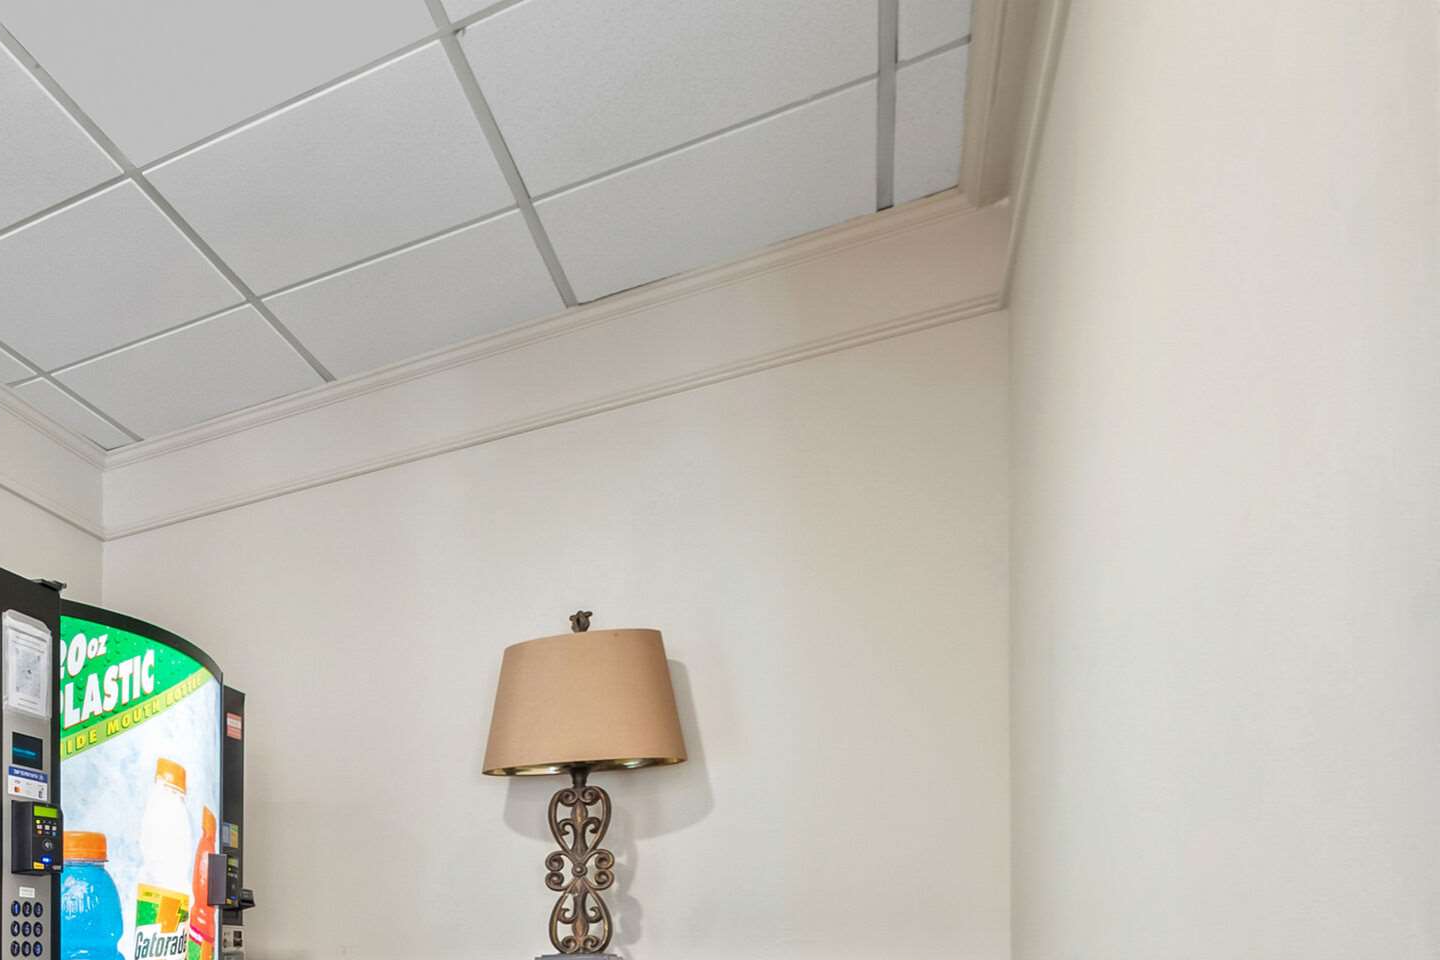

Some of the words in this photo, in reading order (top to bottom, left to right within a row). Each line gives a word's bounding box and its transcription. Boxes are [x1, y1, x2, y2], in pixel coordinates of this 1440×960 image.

[60, 648, 155, 730] LASTIC
[60, 731, 97, 755] IDE
[106, 699, 160, 736] MOUTH
